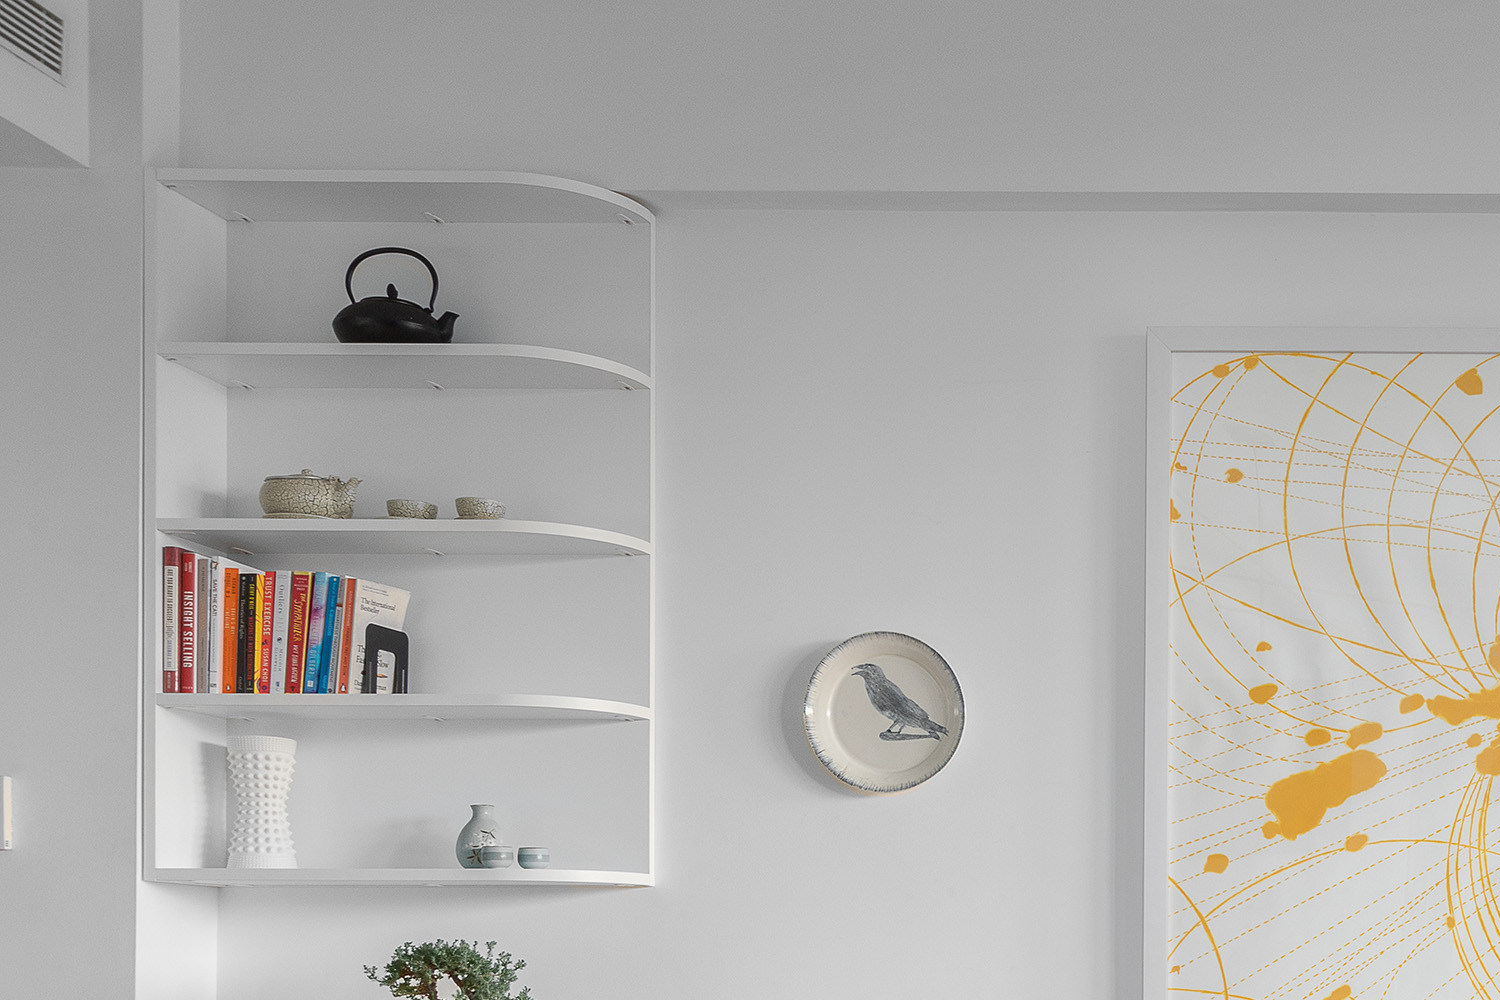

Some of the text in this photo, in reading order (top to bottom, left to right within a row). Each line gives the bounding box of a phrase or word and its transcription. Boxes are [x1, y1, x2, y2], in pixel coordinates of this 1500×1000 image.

[263, 602, 272, 636] EXERCISE
[293, 600, 303, 642] SYMPATHIZER
[370, 599, 396, 611] International
[183, 591, 193, 668] INSIGHT SELLING
[308, 650, 317, 675] GILBERT
